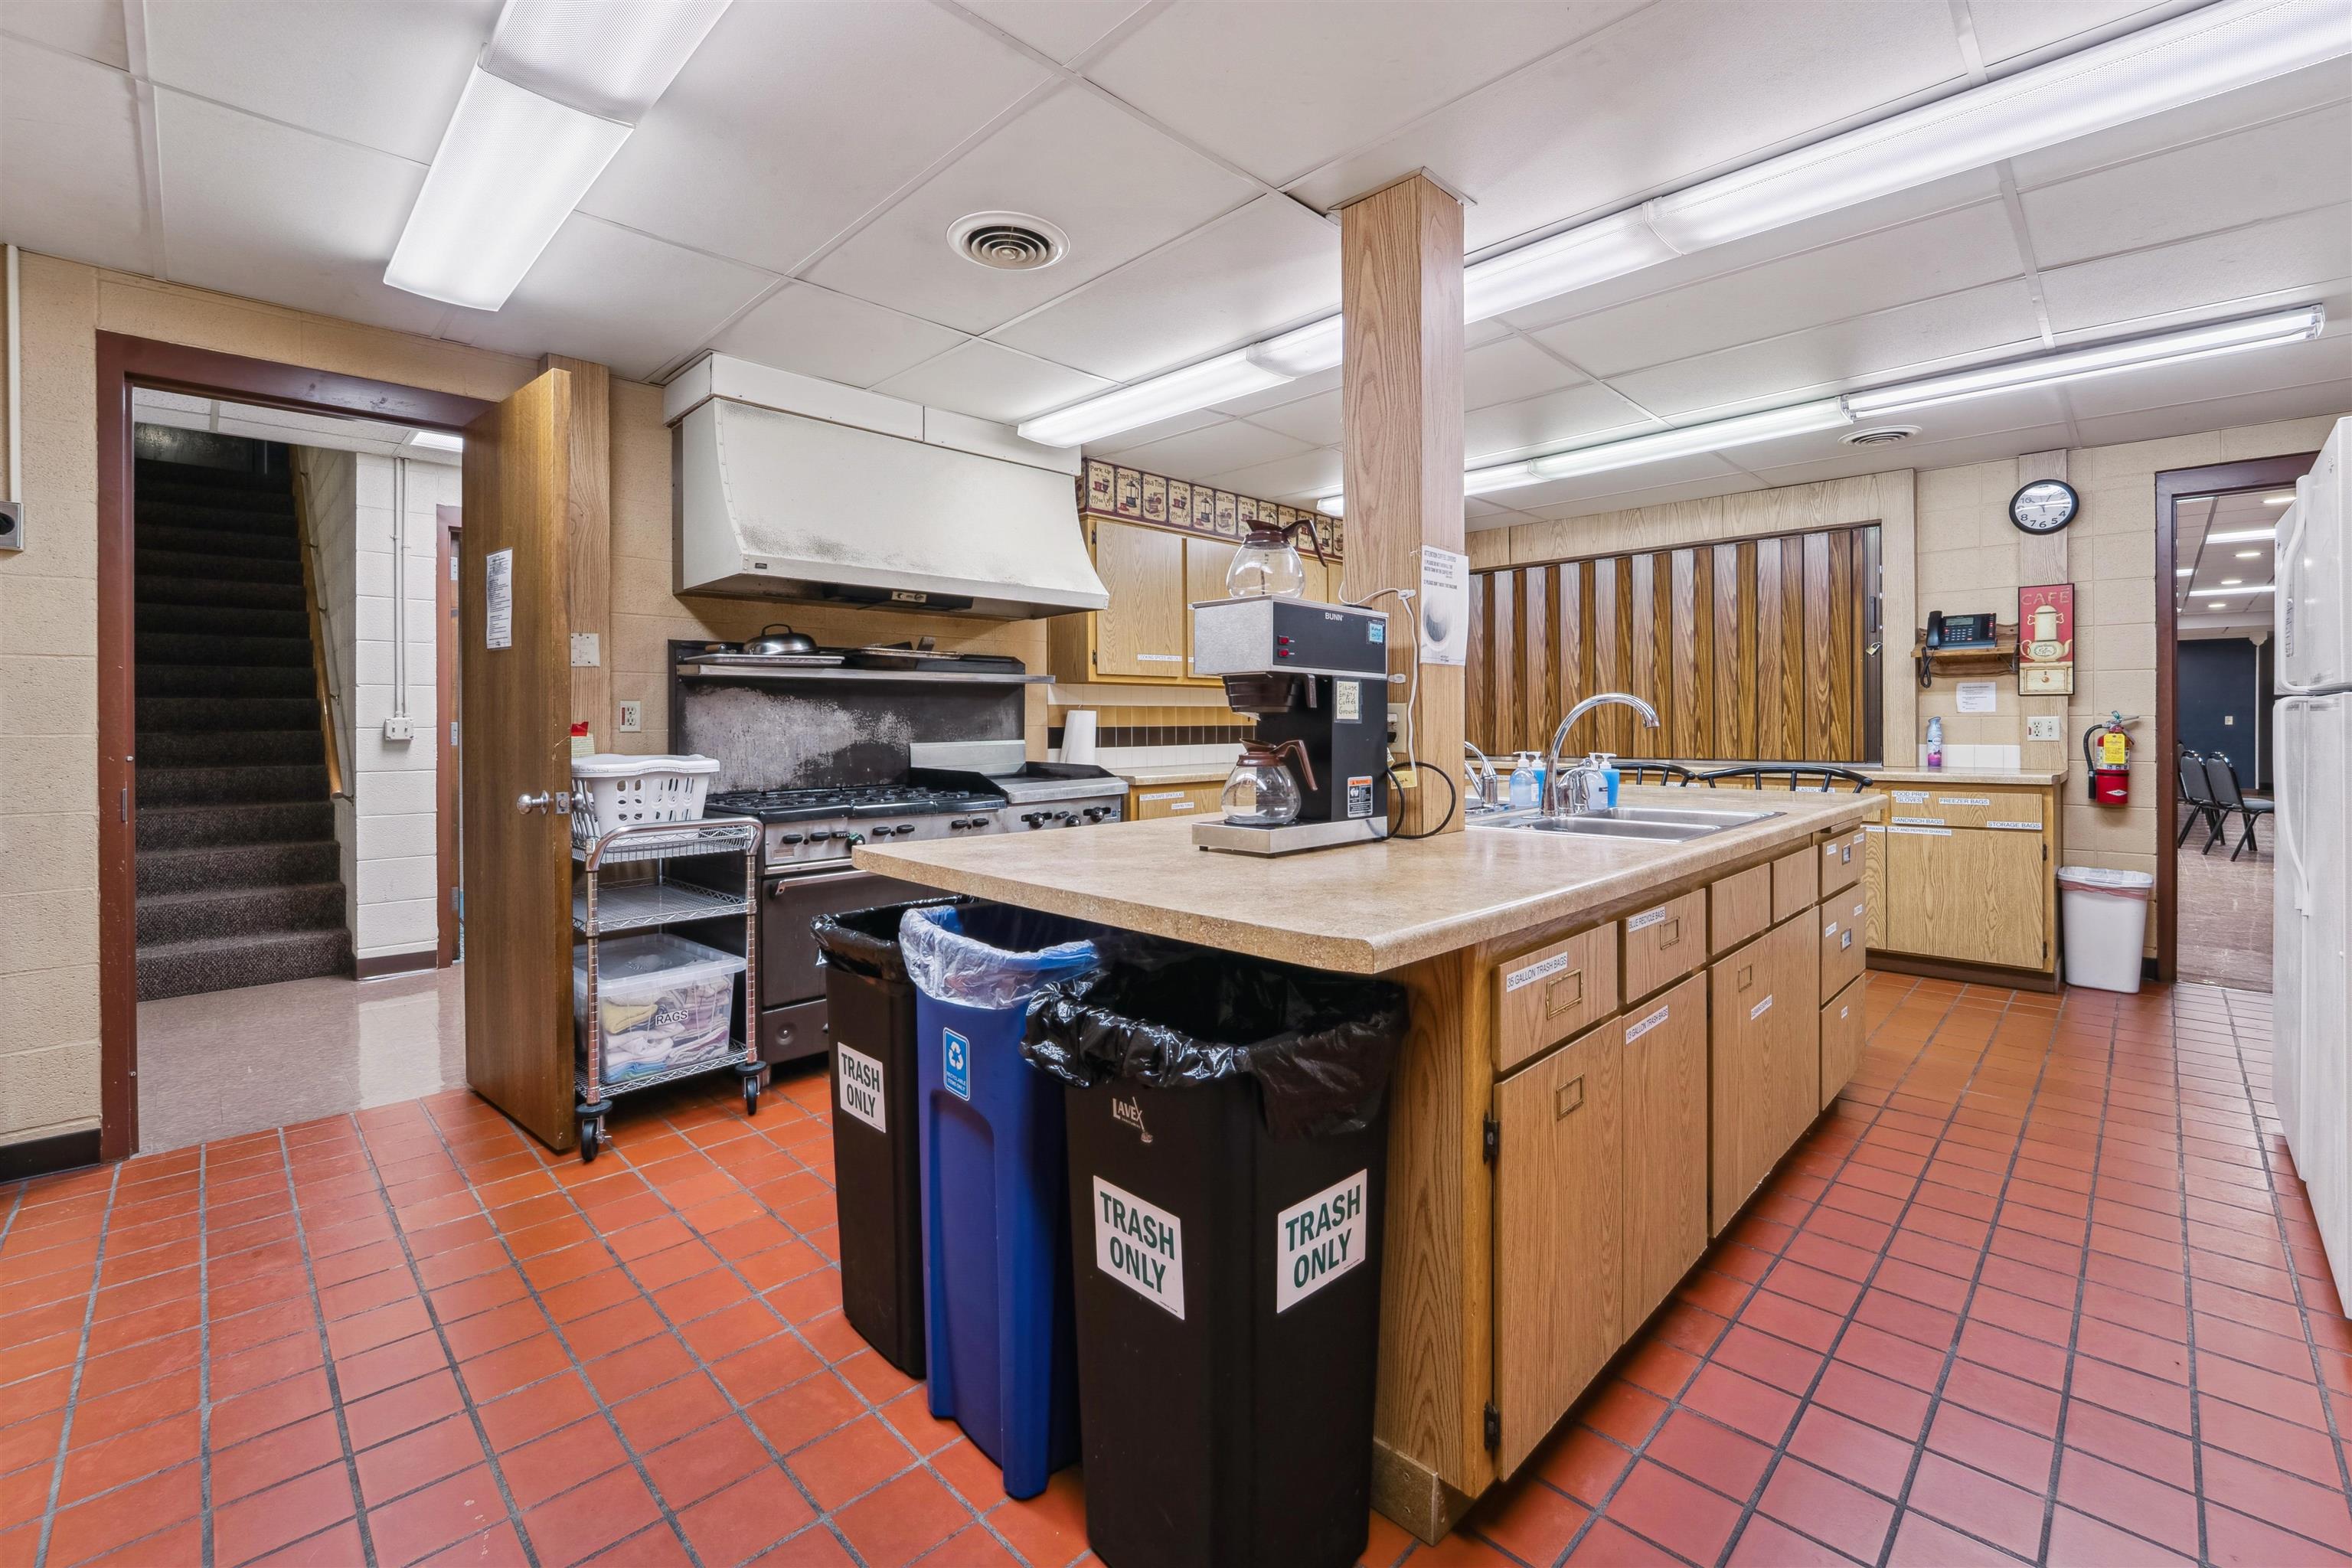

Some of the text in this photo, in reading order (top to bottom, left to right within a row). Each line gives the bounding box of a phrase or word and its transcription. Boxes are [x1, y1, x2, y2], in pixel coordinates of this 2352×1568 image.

[2021, 587, 2069, 606] CAFÉ
[1325, 612, 1343, 621] BUNN
[1629, 918, 1638, 929] BLUE
[1639, 913, 1655, 925] RECYCLE
[1507, 956, 1566, 988] 35 GALLON TRASH BAGS
[656, 1010, 688, 1025] RAGS
[1632, 1023, 1647, 1037] GALLON
[1647, 1015, 1658, 1027] TRASH
[1658, 1008, 1668, 1020] BAGS
[841, 1052, 880, 1093] TRASH
[847, 1083, 876, 1118] ONLY
[1112, 1097, 1142, 1122] LAVEX
[1099, 1191, 1175, 1260] TRASH
[1285, 1184, 1361, 1253] TRASH
[1109, 1236, 1166, 1294] ONLY
[1293, 1227, 1352, 1289] ONLY
